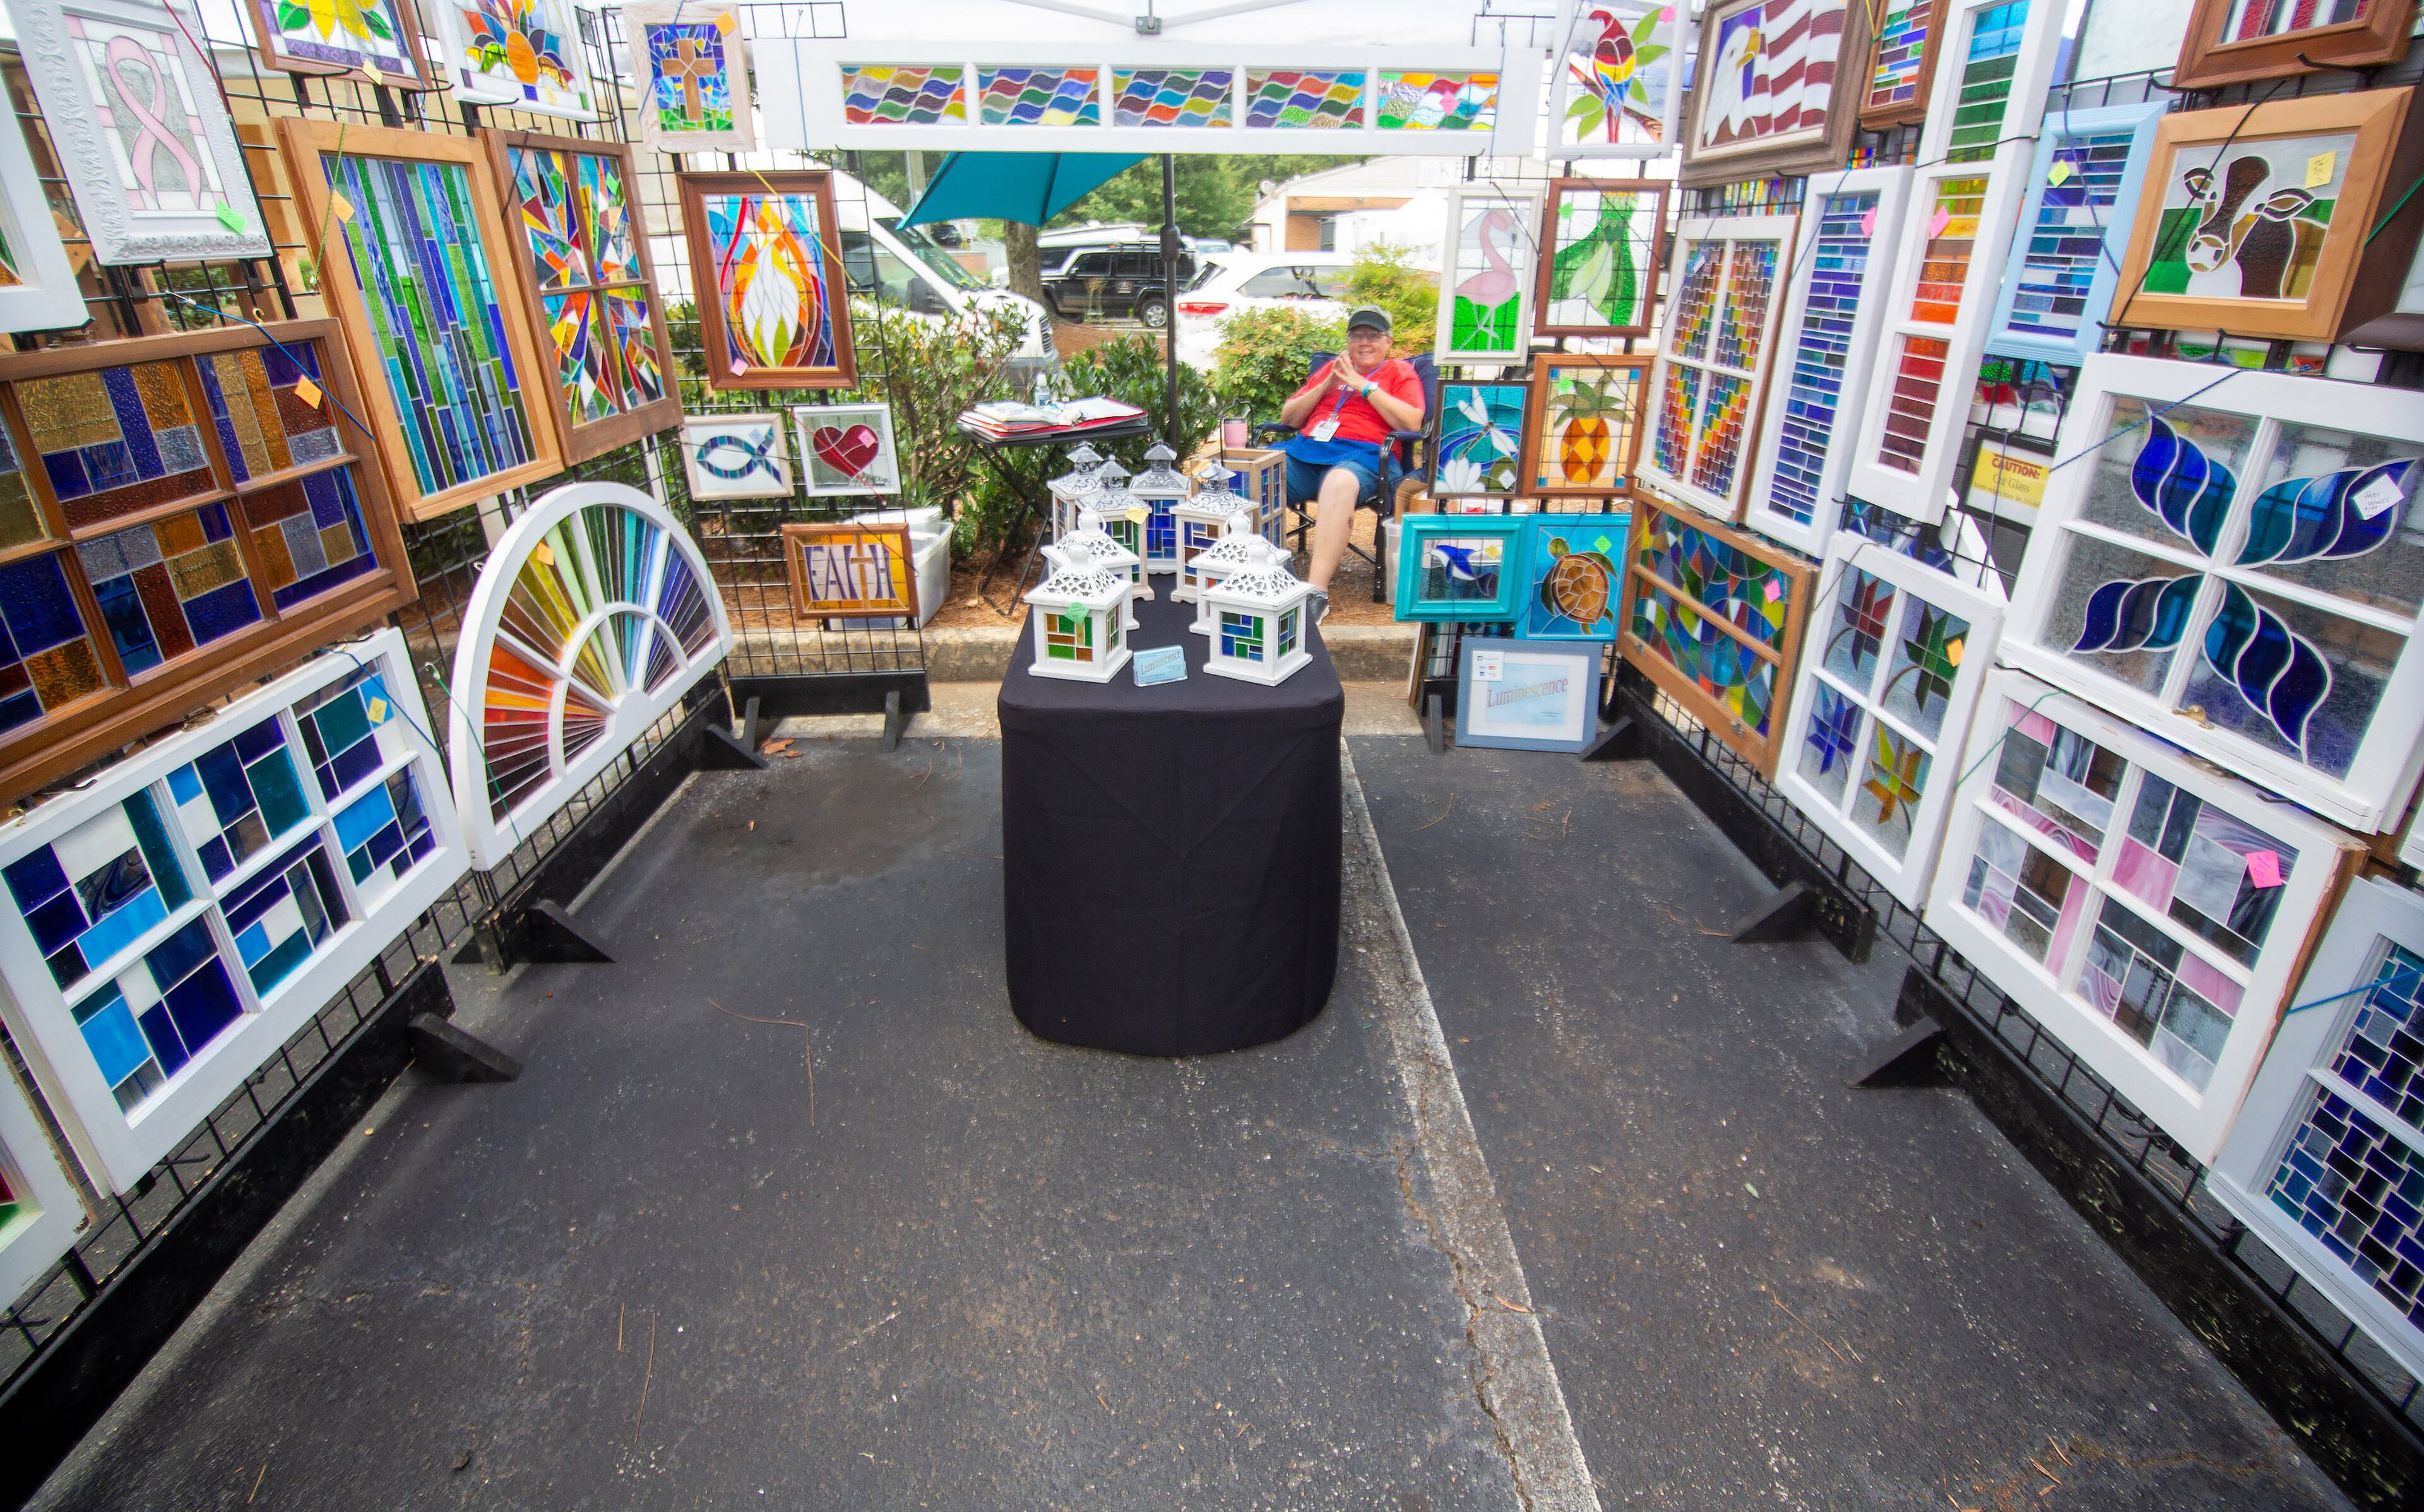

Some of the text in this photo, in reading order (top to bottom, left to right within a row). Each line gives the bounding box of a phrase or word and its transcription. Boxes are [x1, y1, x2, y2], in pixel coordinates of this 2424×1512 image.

[2008, 478, 2030, 493] Glass
[804, 545, 897, 601] FAITH
[1140, 650, 1181, 675] Luminescence
[1487, 678, 1569, 708] Luminescence
